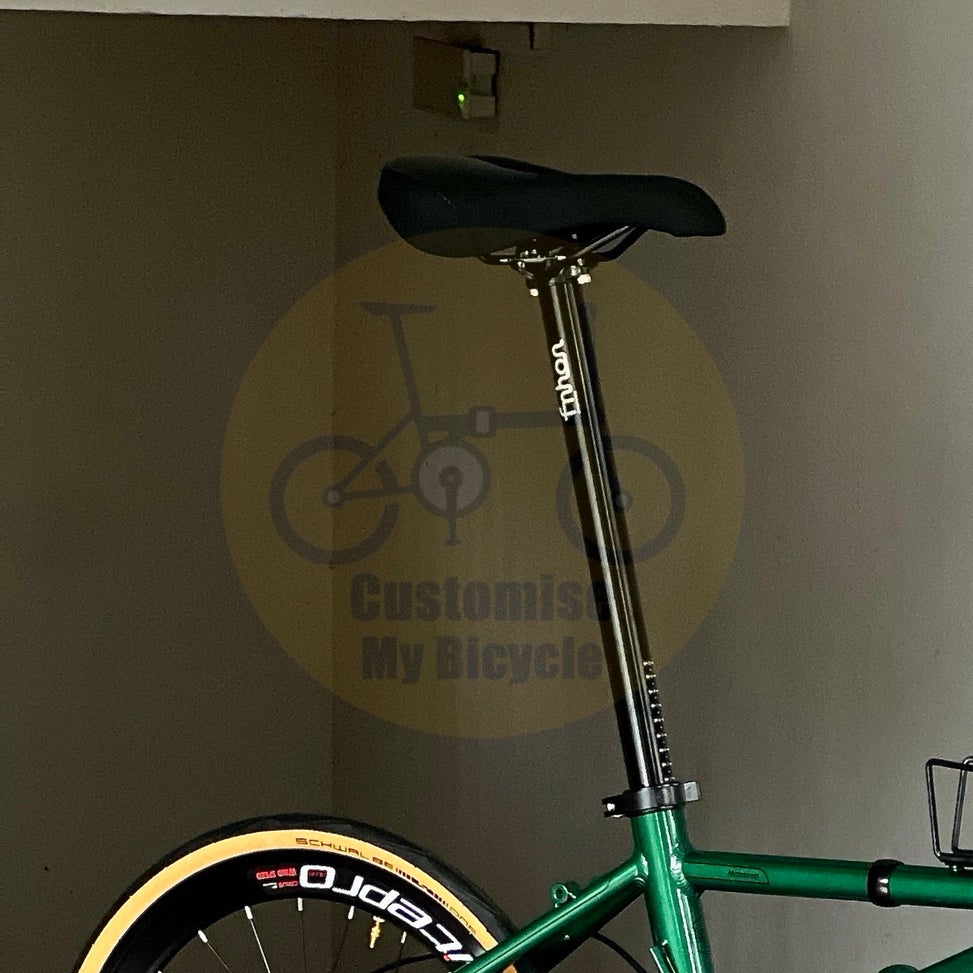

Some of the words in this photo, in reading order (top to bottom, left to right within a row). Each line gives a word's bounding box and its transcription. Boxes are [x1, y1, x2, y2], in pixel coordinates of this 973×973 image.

[552, 338, 581, 421] fnhon
[295, 837, 394, 870] SCHWALBE
[299, 864, 476, 962] itepro
